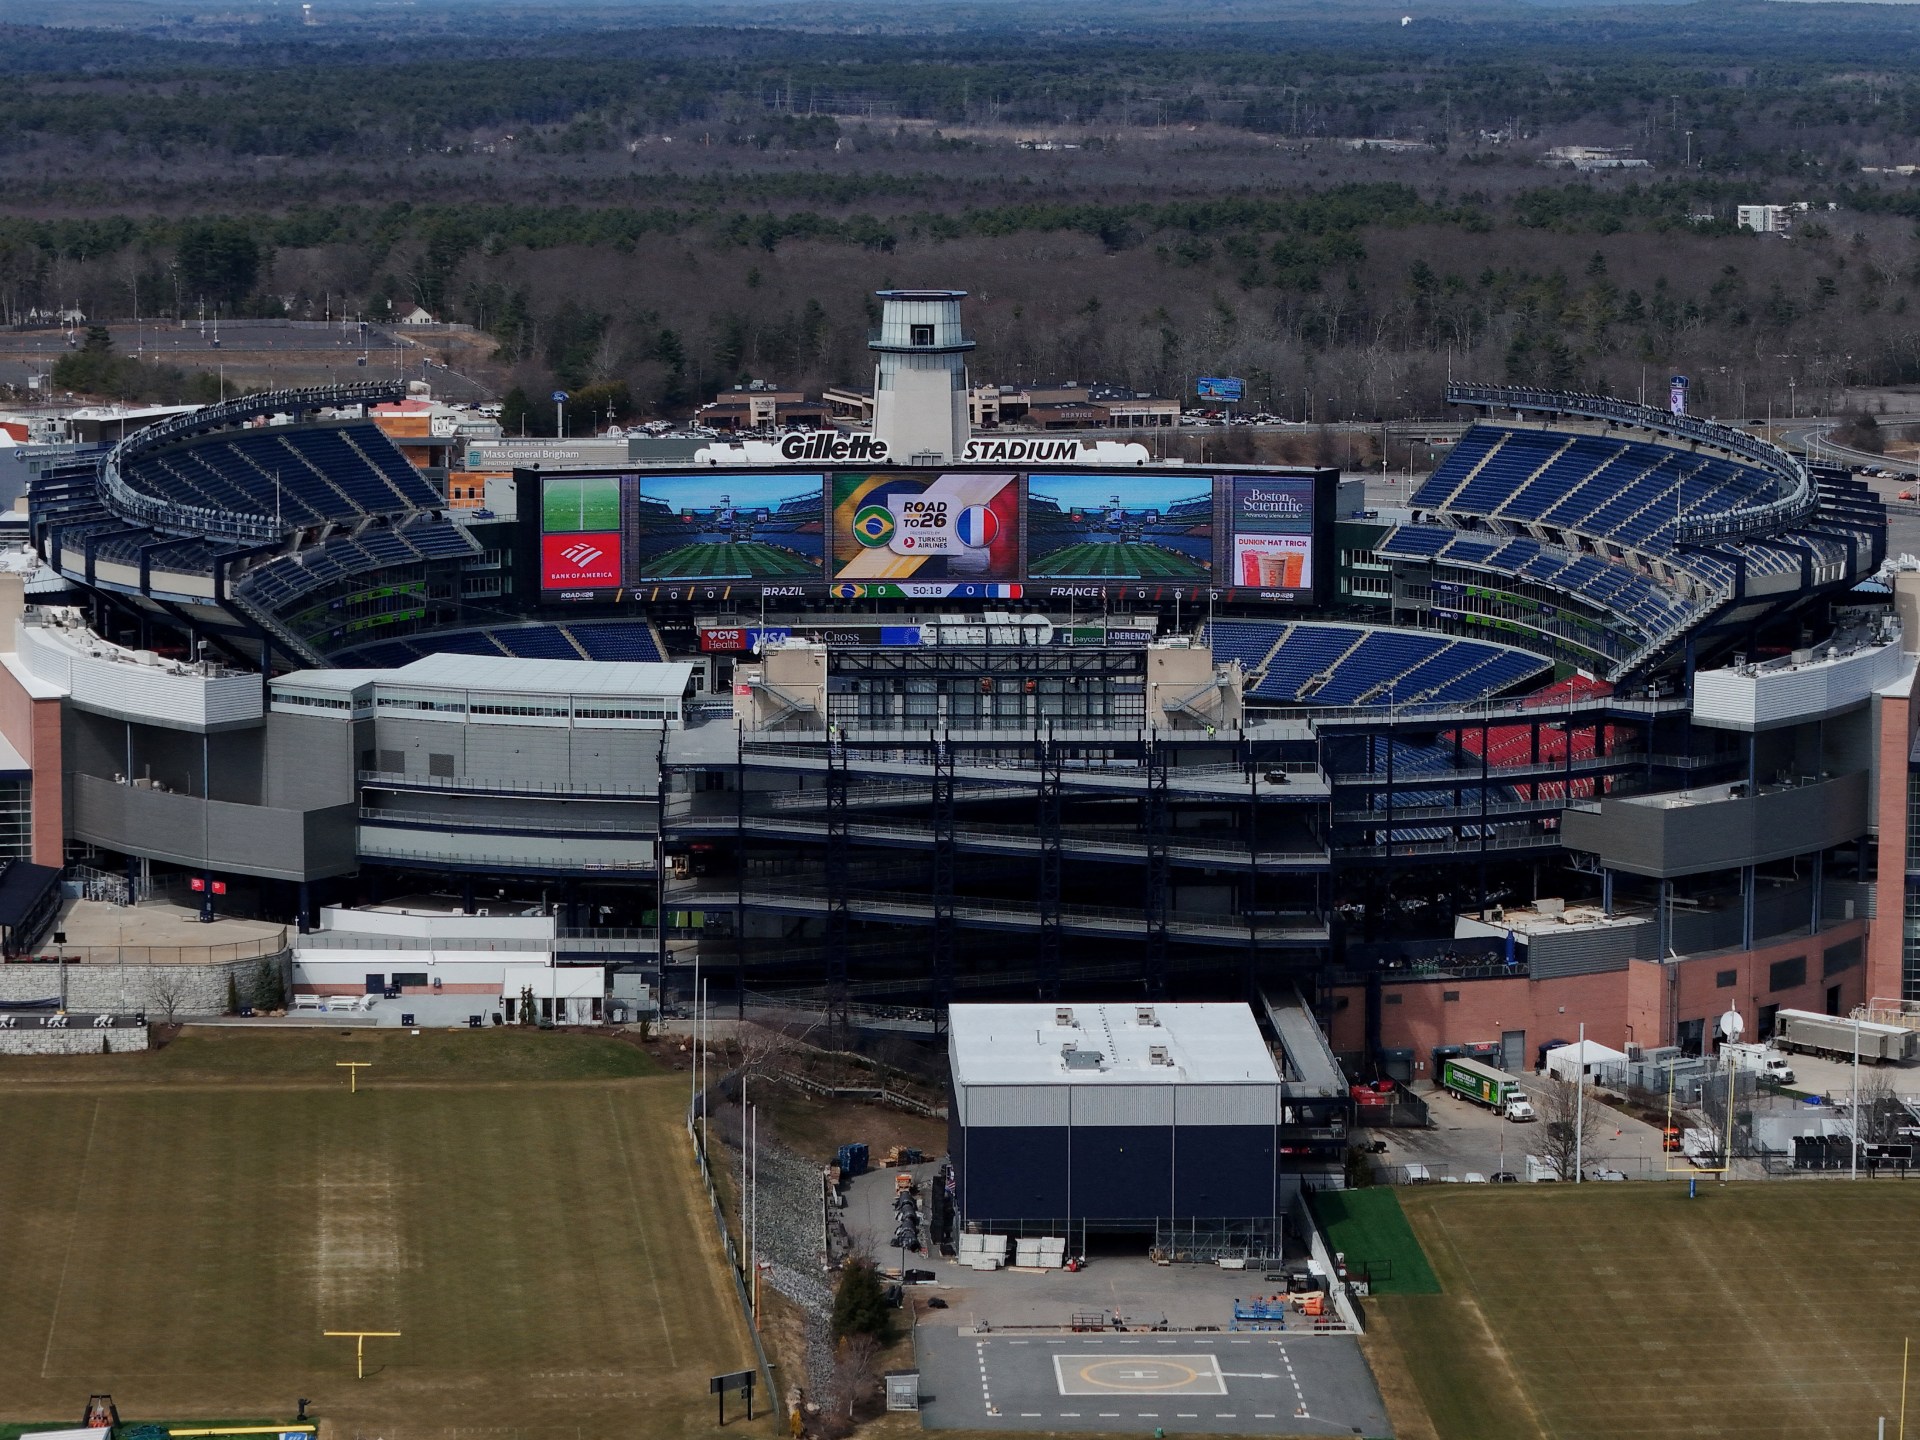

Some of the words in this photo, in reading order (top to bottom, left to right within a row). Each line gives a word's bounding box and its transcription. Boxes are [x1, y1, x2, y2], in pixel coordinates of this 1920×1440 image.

[781, 432, 888, 460] Gillette
[964, 440, 1078, 460] STADIUM
[483, 450, 506, 458] Mass
[508, 450, 540, 458] General
[542, 450, 579, 460] Brigham
[1252, 488, 1289, 502] Boston
[904, 502, 948, 512] ROAD
[1244, 496, 1303, 512] Scientific
[904, 519, 920, 528] TO
[763, 587, 805, 596] BRAZIL
[878, 586, 886, 595] 0
[912, 586, 942, 594] 50:18
[966, 586, 974, 595] 0
[1050, 588, 1098, 596] FRANCE
[718, 631, 739, 639] CVS
[750, 632, 786, 646] VISA
[824, 631, 859, 642] CROSS
[1108, 632, 1150, 640] J.DERENZO
[709, 640, 739, 649] Health
